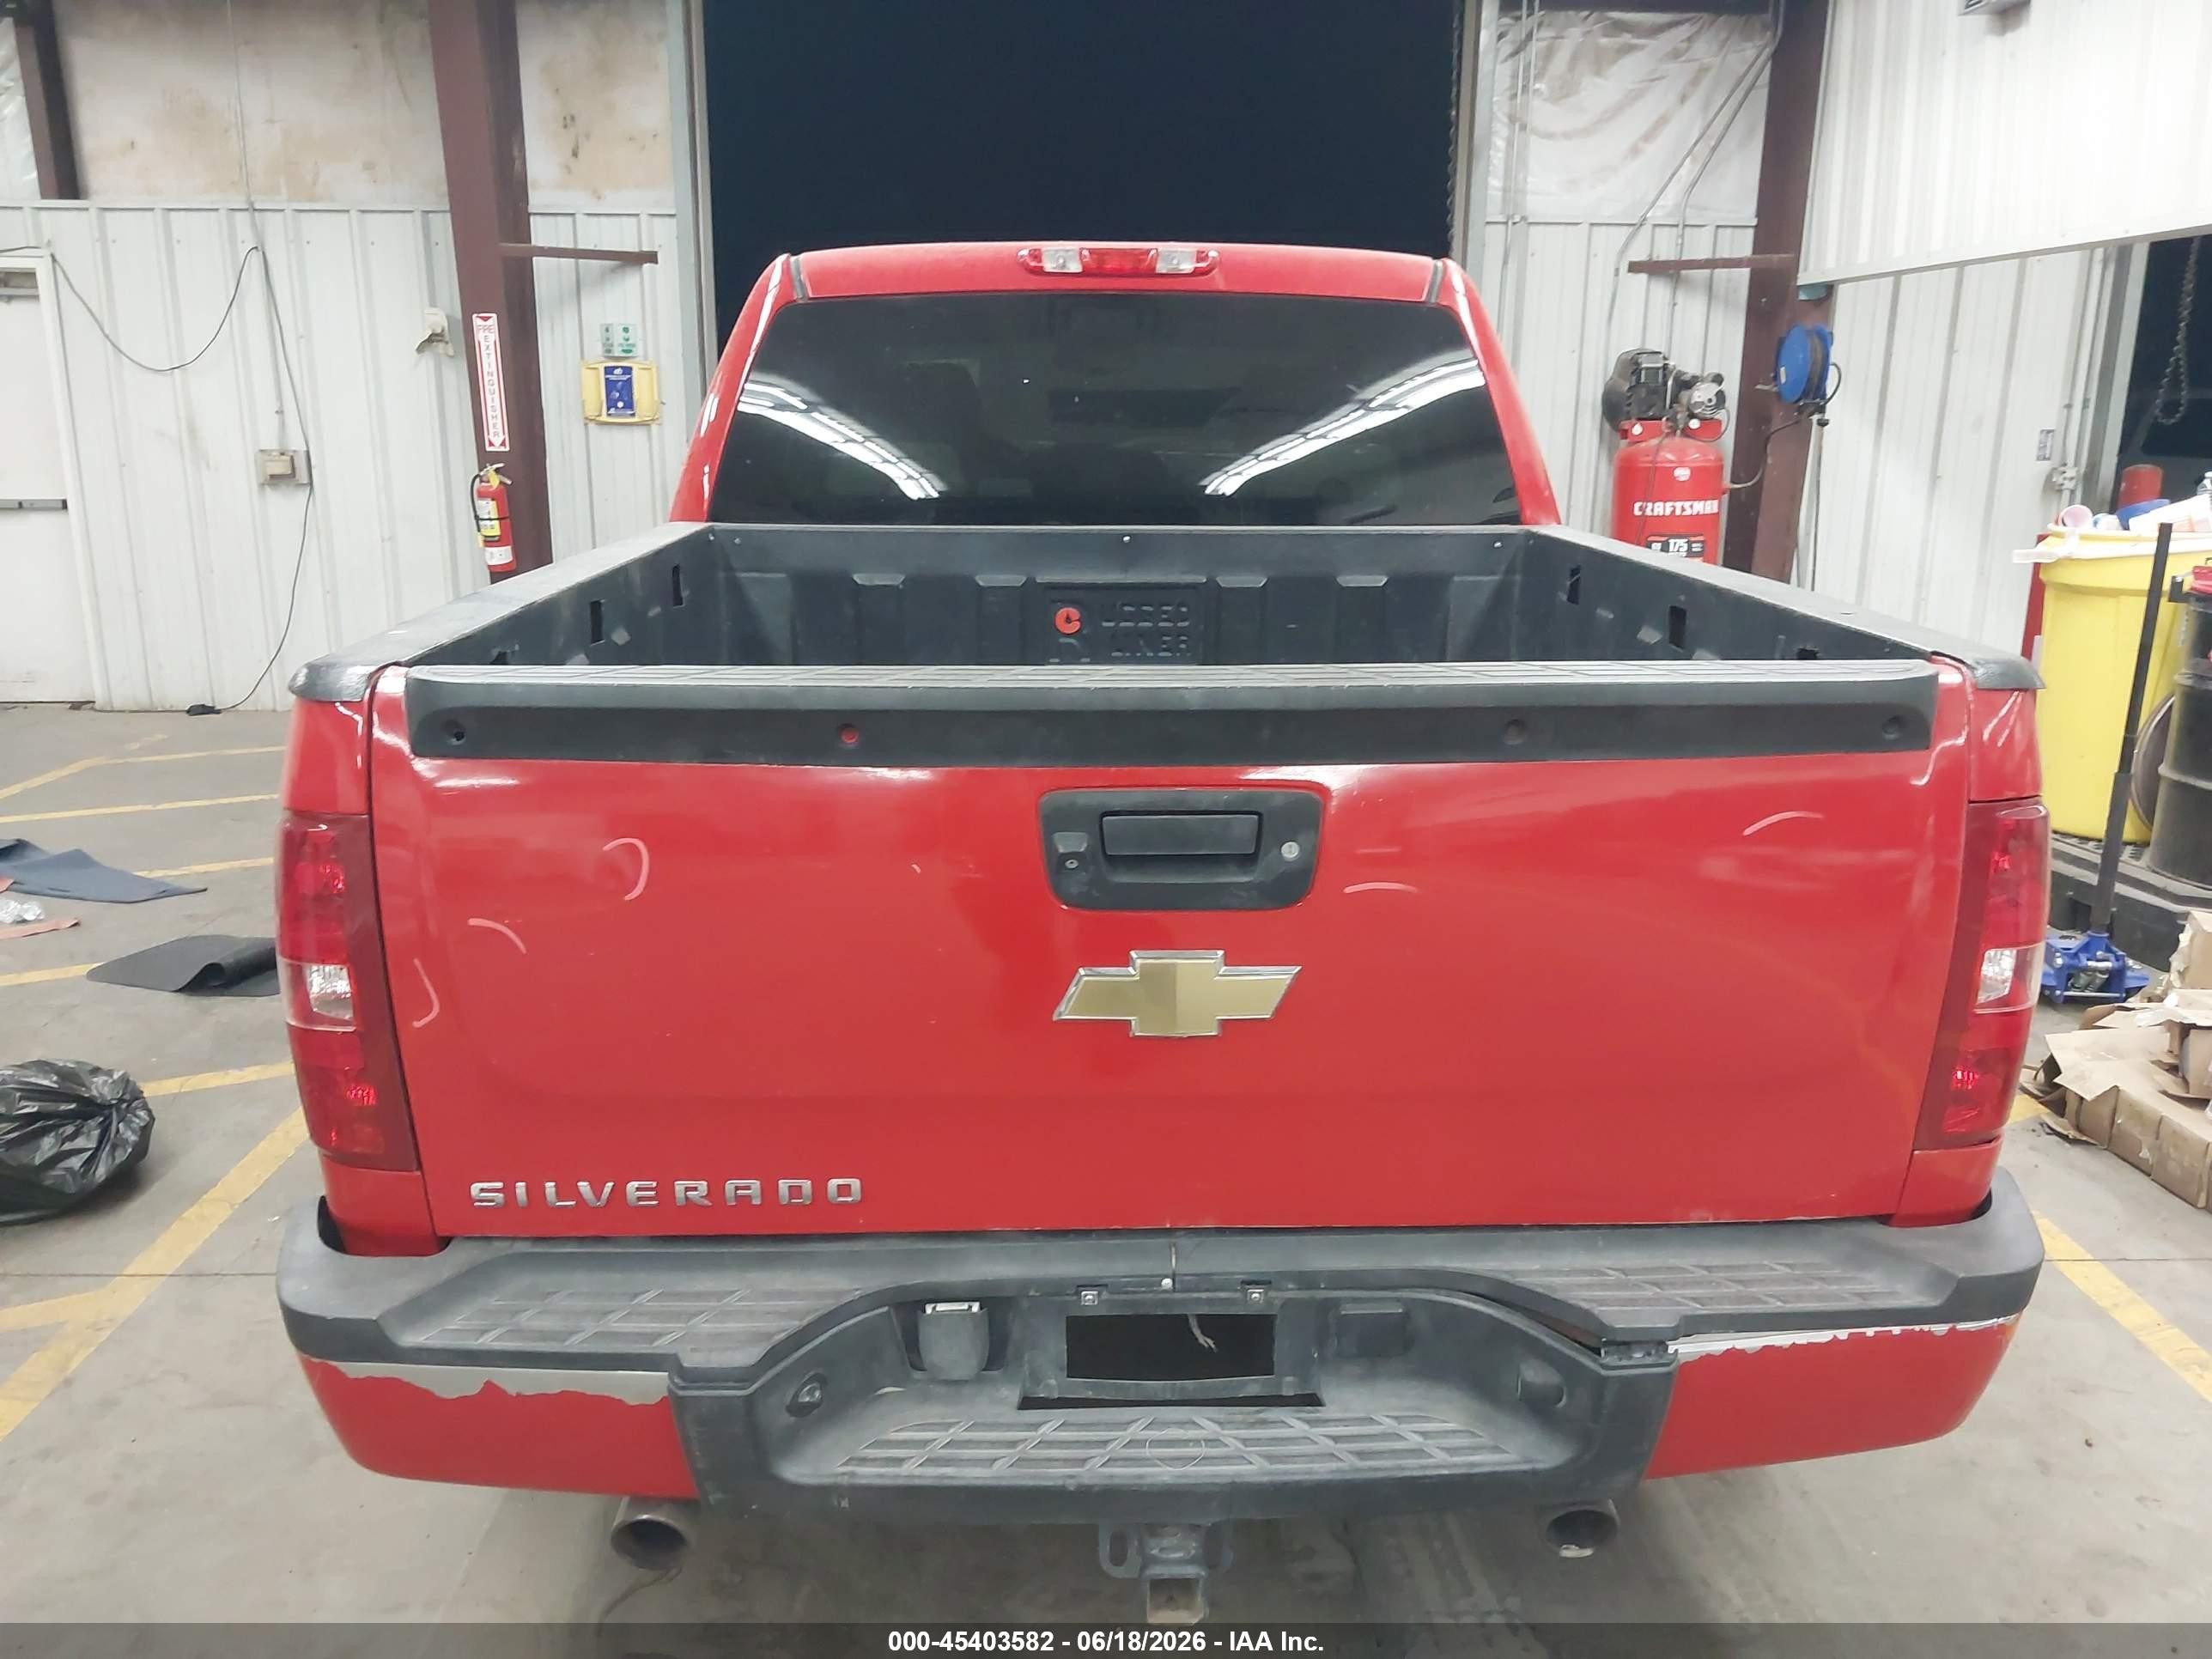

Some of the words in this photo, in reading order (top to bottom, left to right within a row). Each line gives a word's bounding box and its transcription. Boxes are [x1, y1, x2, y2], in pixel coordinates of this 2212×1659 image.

[483, 335, 501, 437] EXTINGUISHER
[1668, 538, 1689, 552] 175
[470, 1178, 862, 1208] SILVERADO
